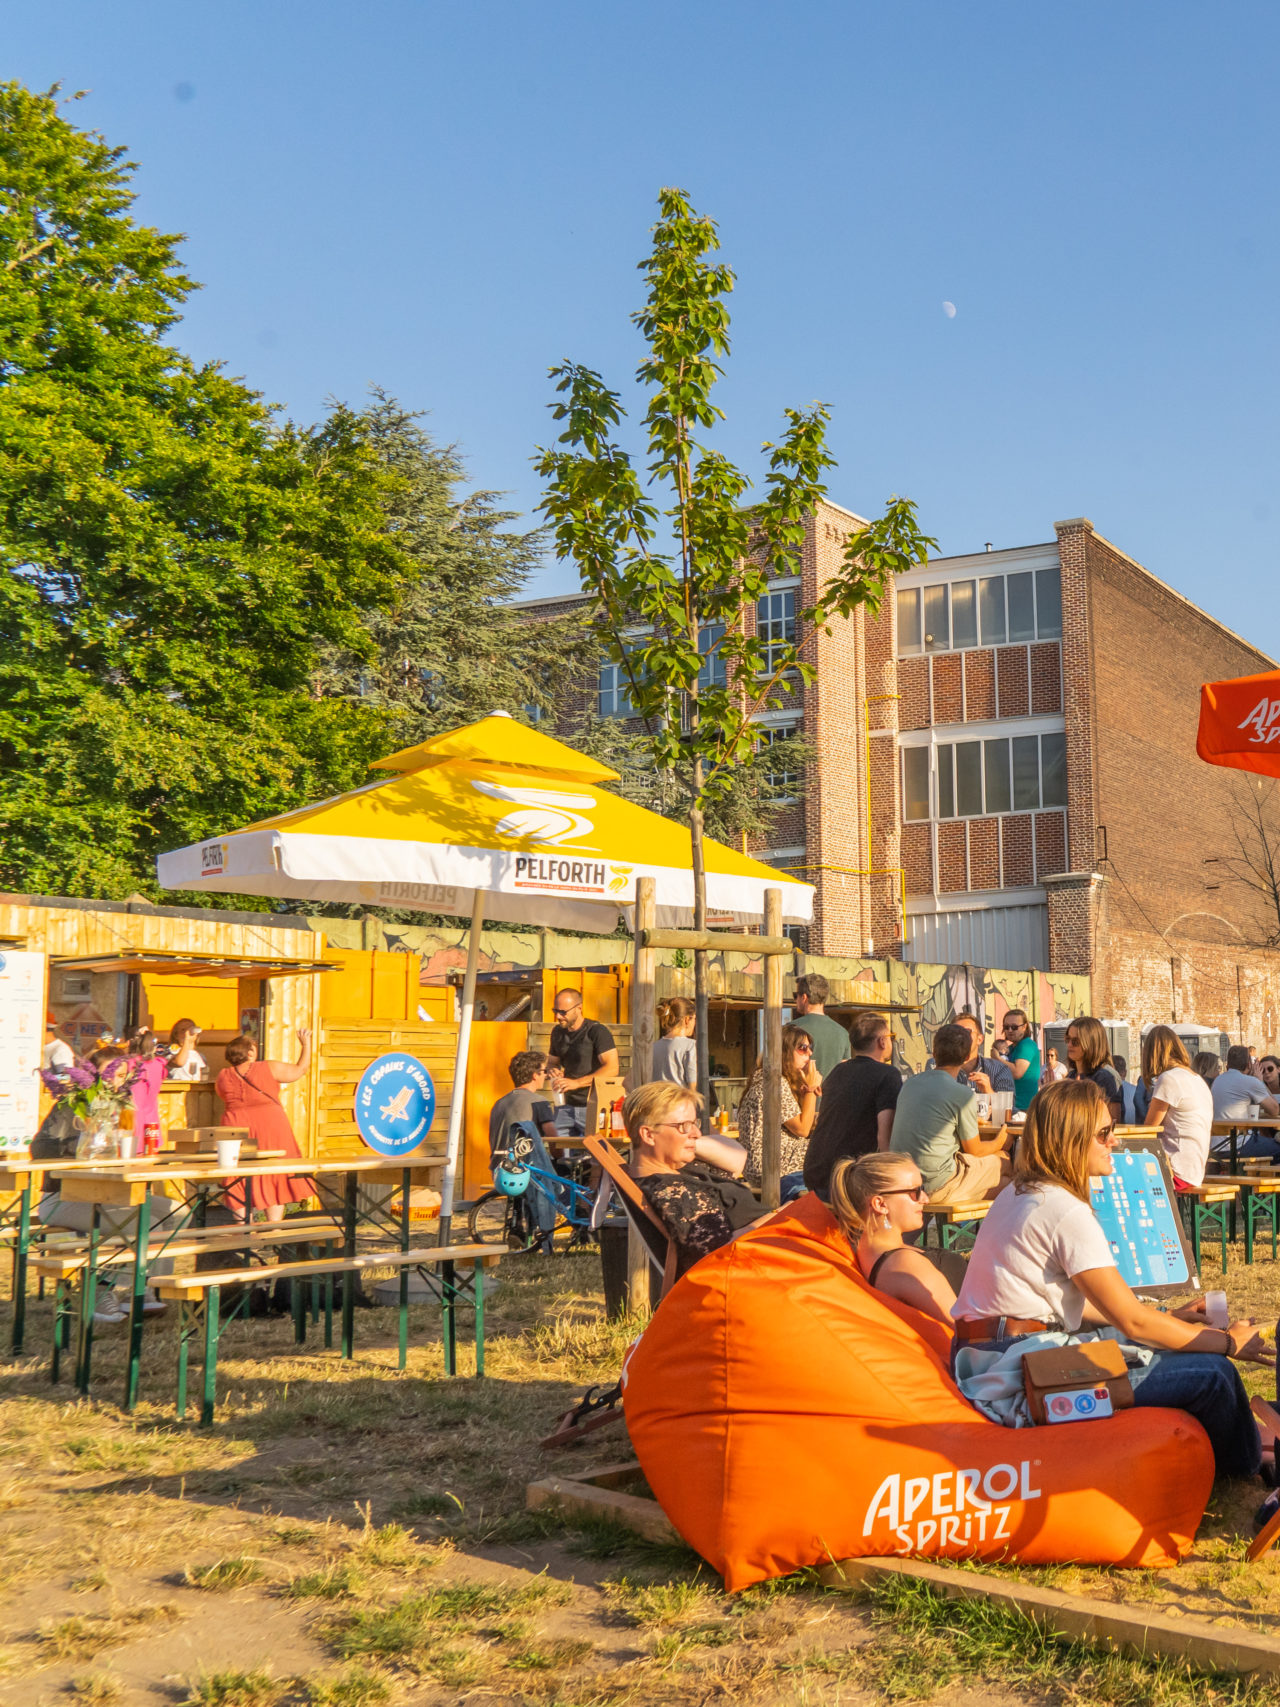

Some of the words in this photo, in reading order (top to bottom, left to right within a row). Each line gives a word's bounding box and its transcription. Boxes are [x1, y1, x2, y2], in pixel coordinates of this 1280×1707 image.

[515, 857, 606, 885] PELFORTH
[362, 1086, 373, 1106] LES
[862, 1461, 1042, 1537] APEROL
